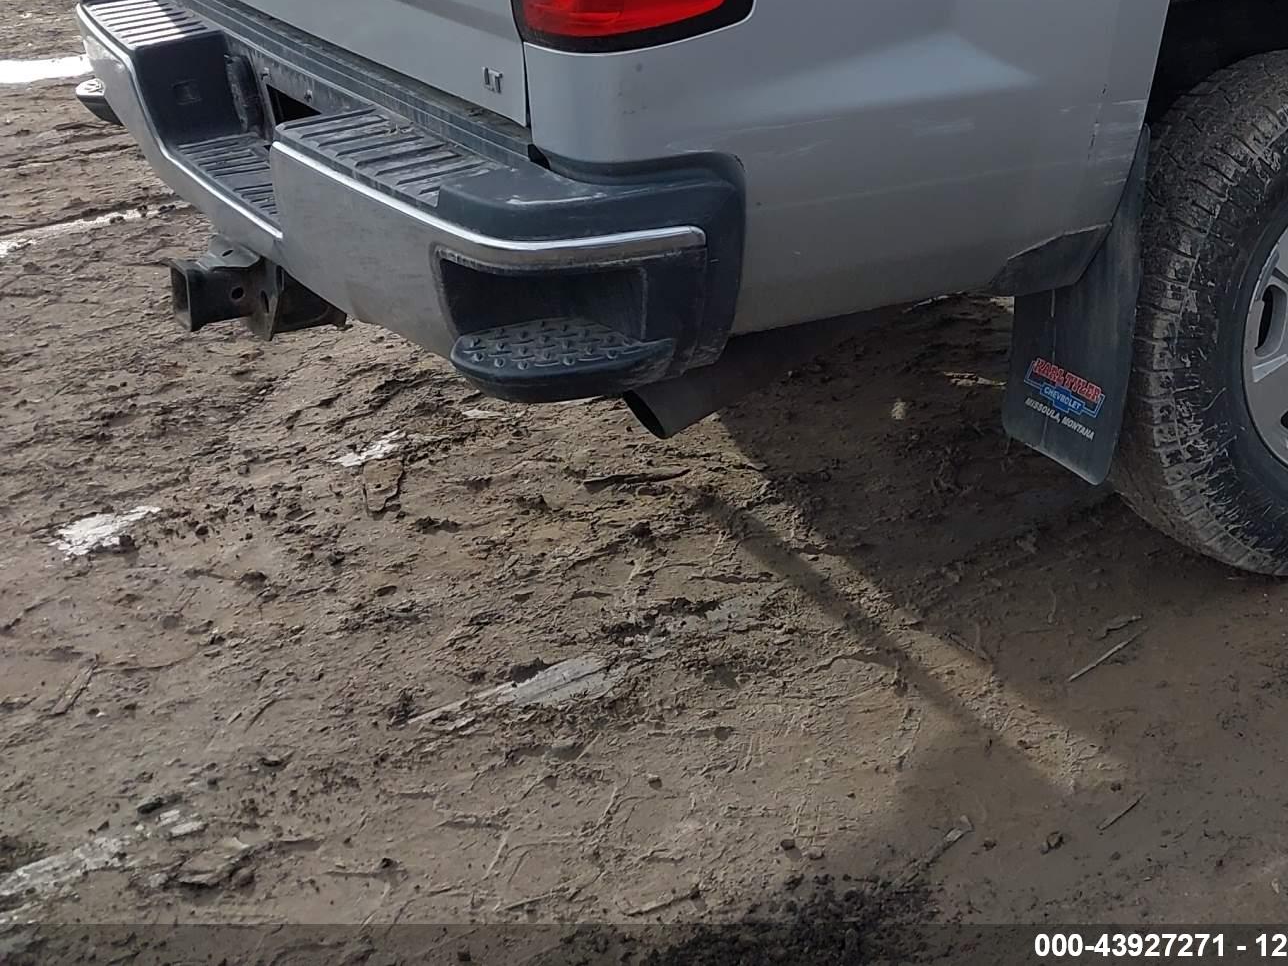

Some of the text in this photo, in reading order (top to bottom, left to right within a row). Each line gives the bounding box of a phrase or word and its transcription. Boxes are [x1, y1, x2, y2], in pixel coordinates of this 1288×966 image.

[482, 66, 503, 94] LT
[1043, 386, 1082, 410] CHEVROLET
[1061, 416, 1096, 441] MONTANA
